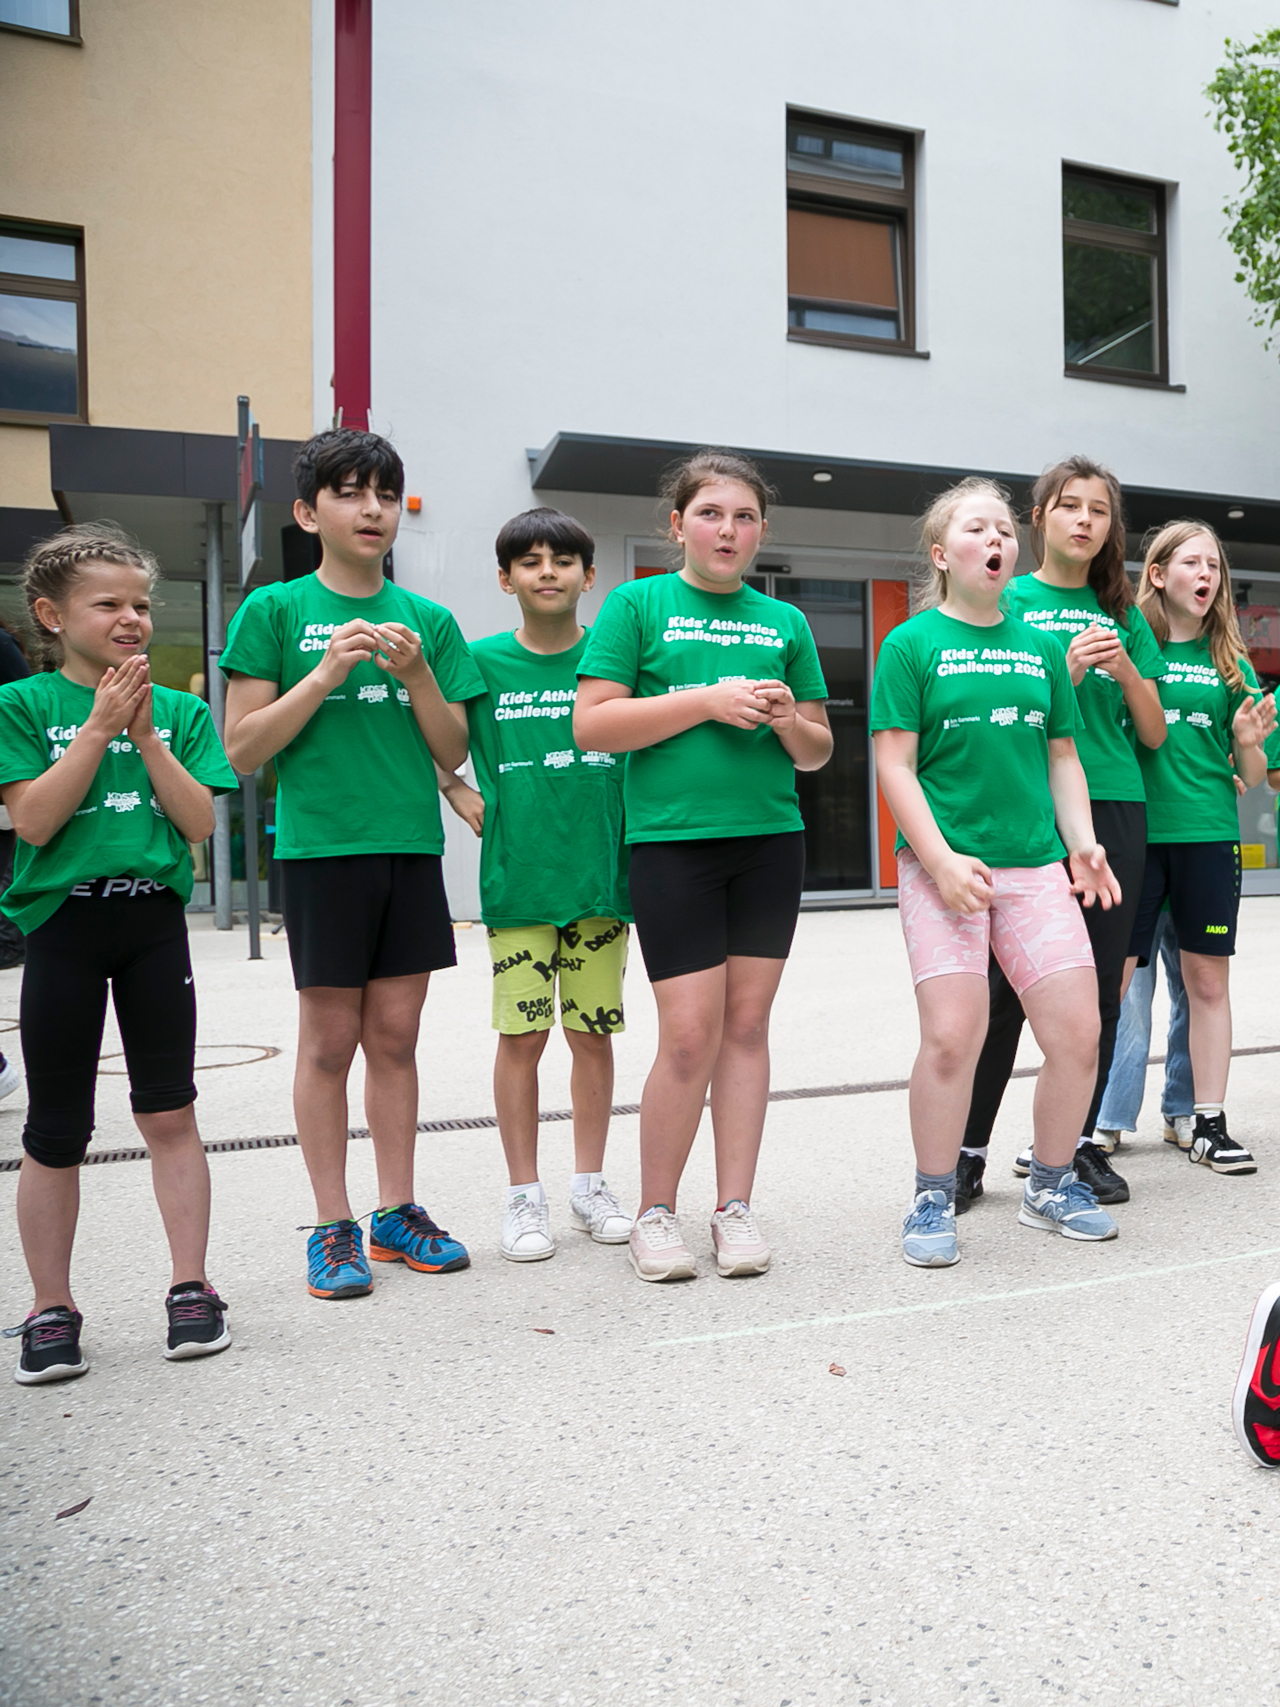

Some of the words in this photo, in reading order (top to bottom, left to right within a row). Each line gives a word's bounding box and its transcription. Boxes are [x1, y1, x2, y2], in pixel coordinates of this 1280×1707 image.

[1023, 608, 1058, 623] Kids'
[1059, 608, 1116, 627] Athletics
[667, 616, 707, 629] Kids'
[709, 618, 778, 637] Athletics
[662, 629, 742, 646] Challenge
[743, 633, 785, 648] 2024
[940, 648, 978, 662] Kids'
[980, 648, 1043, 666] Athletics
[936, 661, 1012, 677] Challenge
[1013, 662, 1046, 679] 2024
[1165, 661, 1218, 677] thletics
[1184, 673, 1220, 687] 2024
[498, 690, 538, 706] Kids'
[494, 705, 571, 721] Challenge
[1205, 924, 1229, 934] JAKO
[516, 996, 552, 1013] BABY
